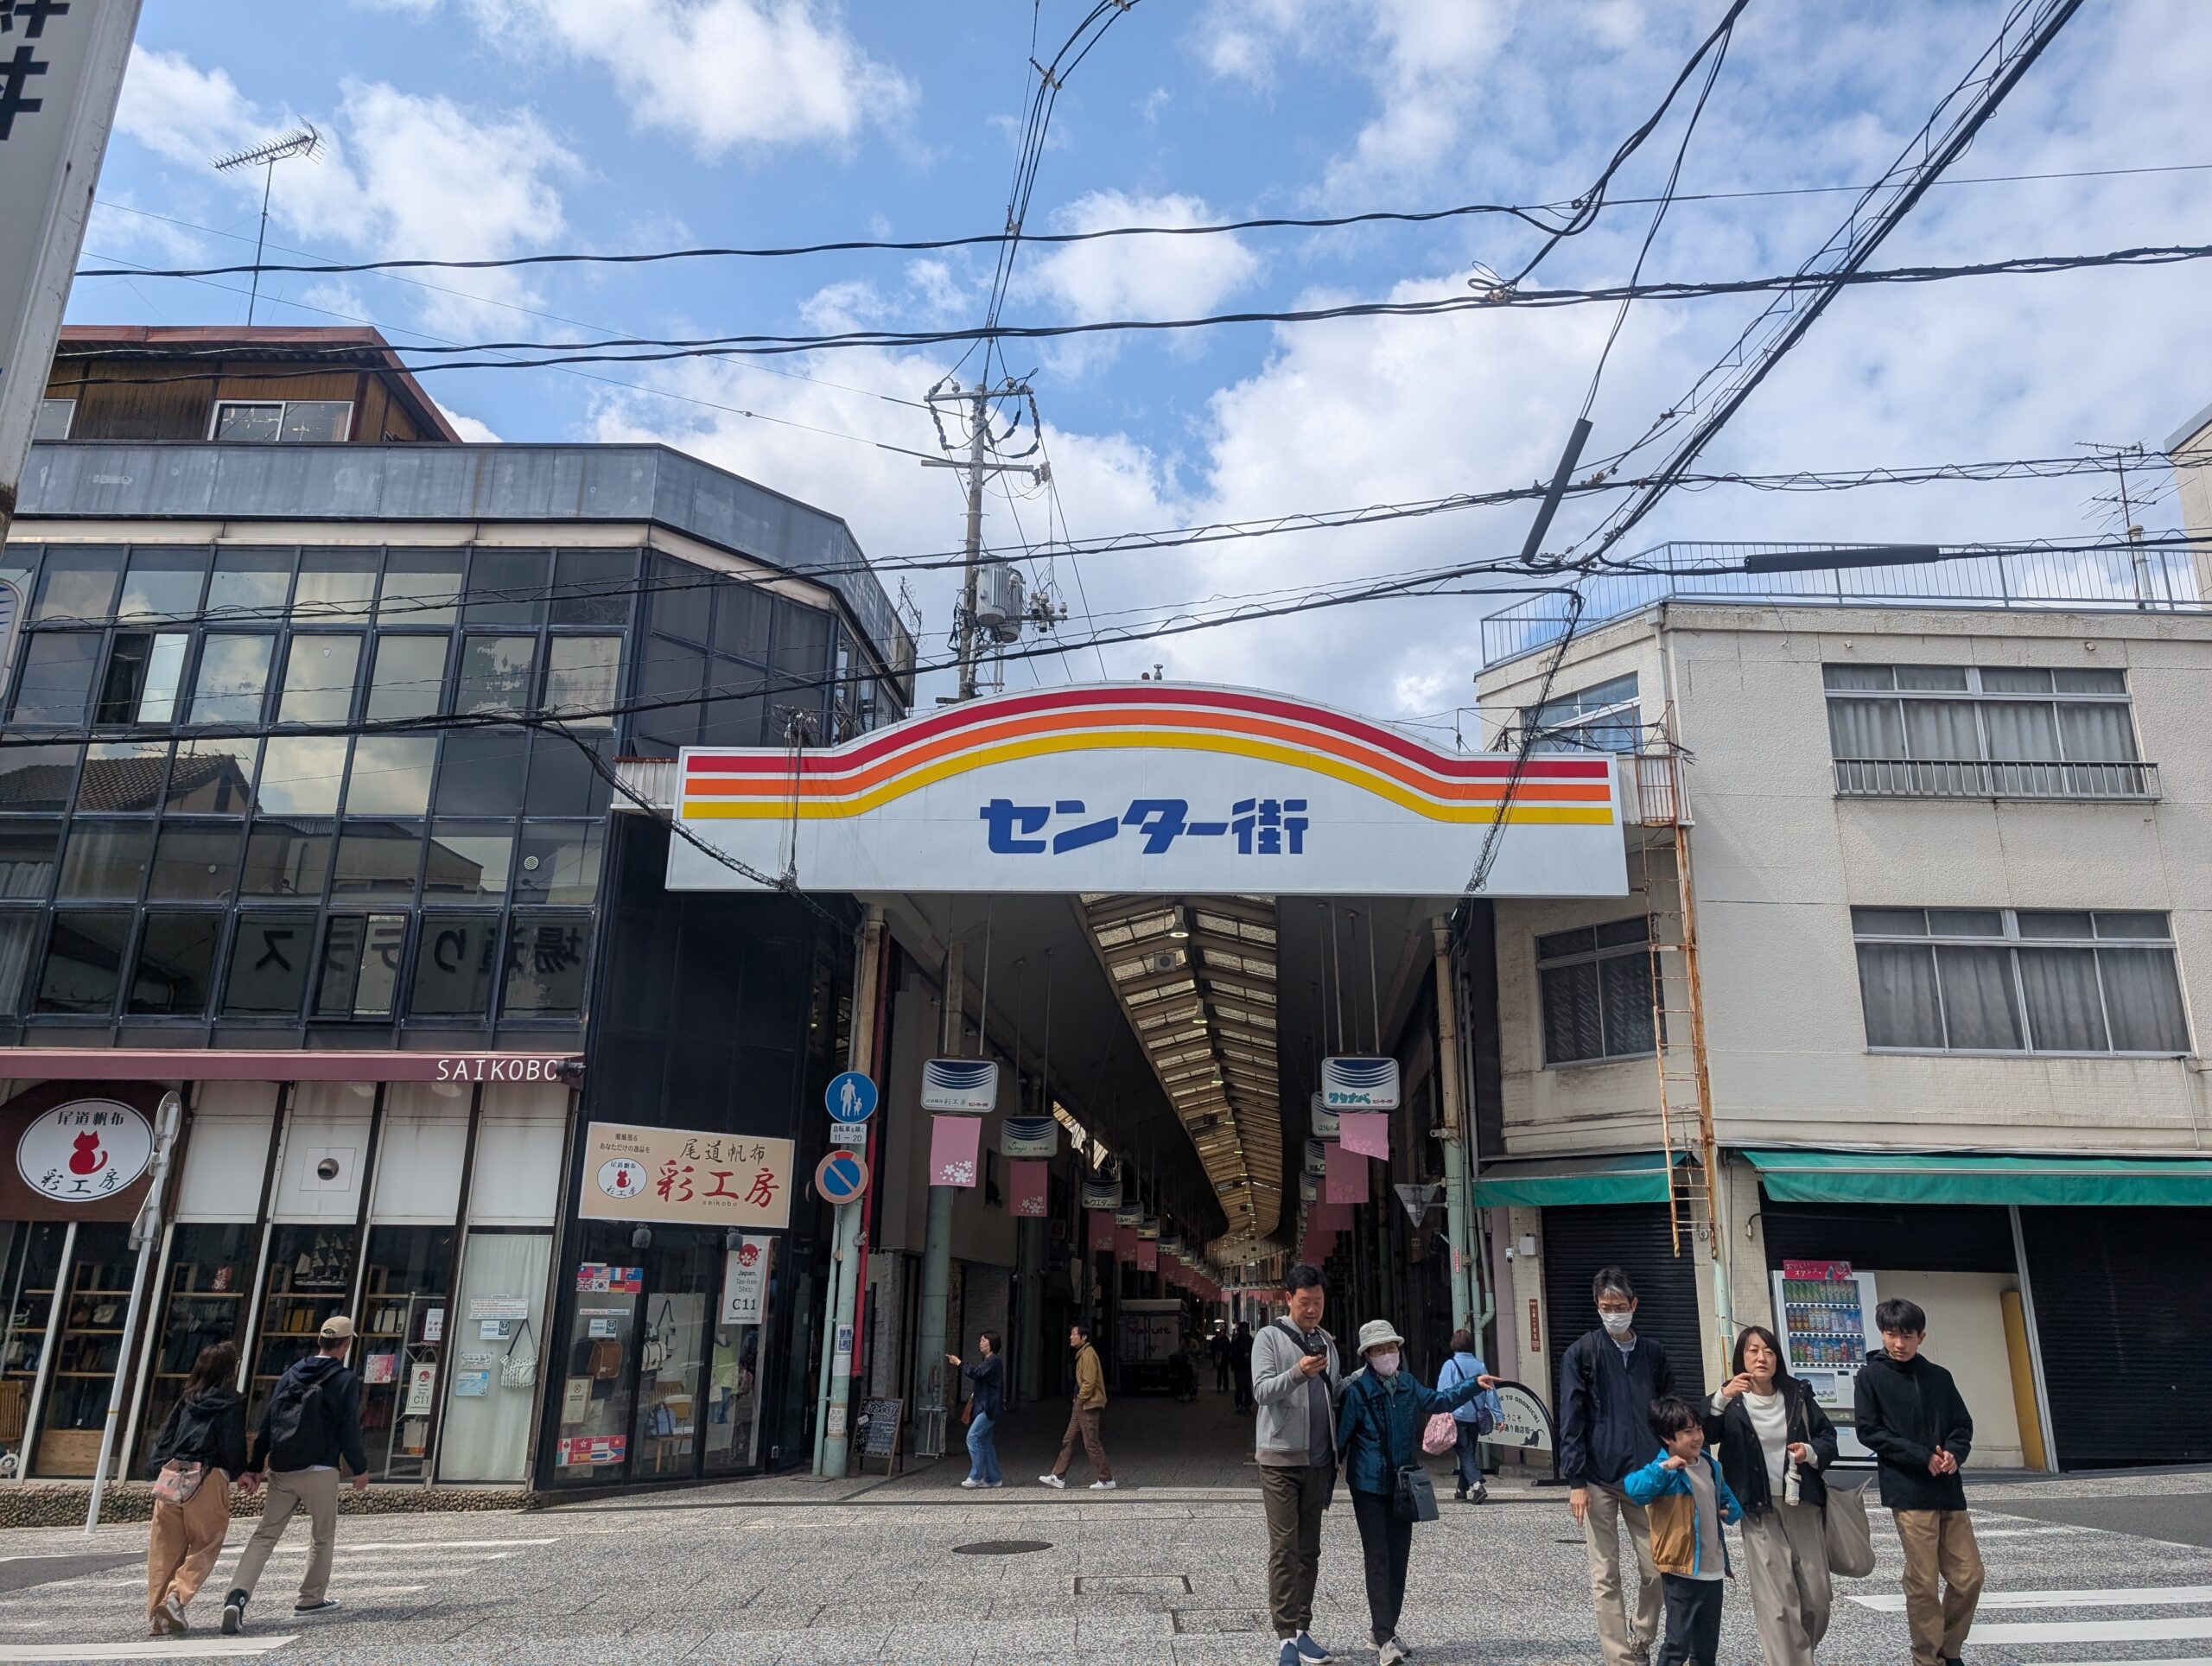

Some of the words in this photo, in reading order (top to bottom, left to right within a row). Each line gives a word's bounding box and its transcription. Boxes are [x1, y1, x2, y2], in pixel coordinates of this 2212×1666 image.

[979, 798, 1308, 855] センター街
[436, 1059, 557, 1081] SAIKOBO
[1328, 1092, 1370, 1104] ワタナベ
[57, 1110, 124, 1126] 尾道帆布
[679, 1138, 766, 1166] 尾道帆布
[41, 1168, 119, 1193] 彩工房
[657, 1160, 779, 1208] 彩工房
[733, 1298, 756, 1310] C11
[414, 1396, 429, 1404] C11
[1515, 1396, 1540, 1424] ONOMICHI
